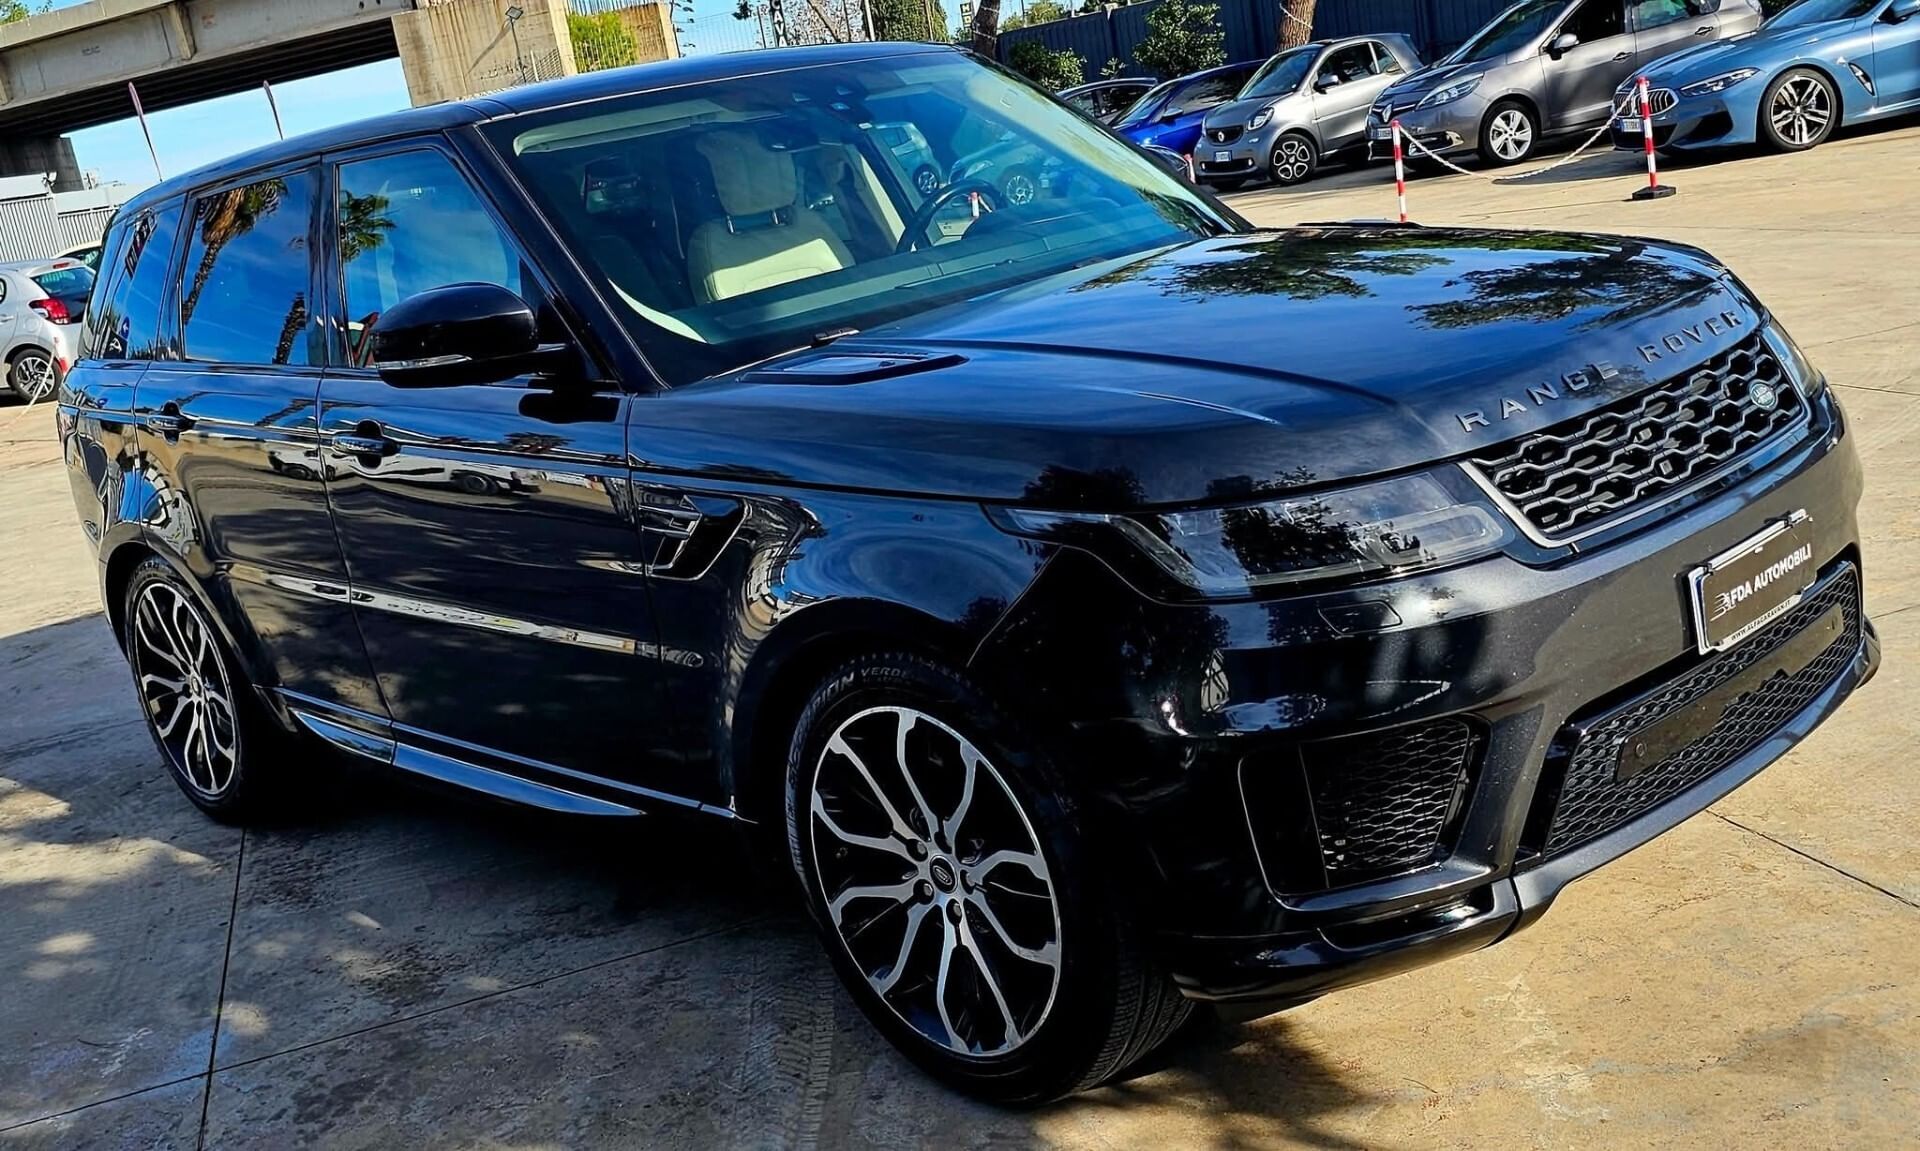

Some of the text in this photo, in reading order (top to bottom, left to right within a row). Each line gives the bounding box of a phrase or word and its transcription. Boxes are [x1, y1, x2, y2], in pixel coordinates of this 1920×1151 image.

[1456, 310, 1742, 433] RANGE ROVER
[1753, 543, 1812, 592] AUTOMOBILI
